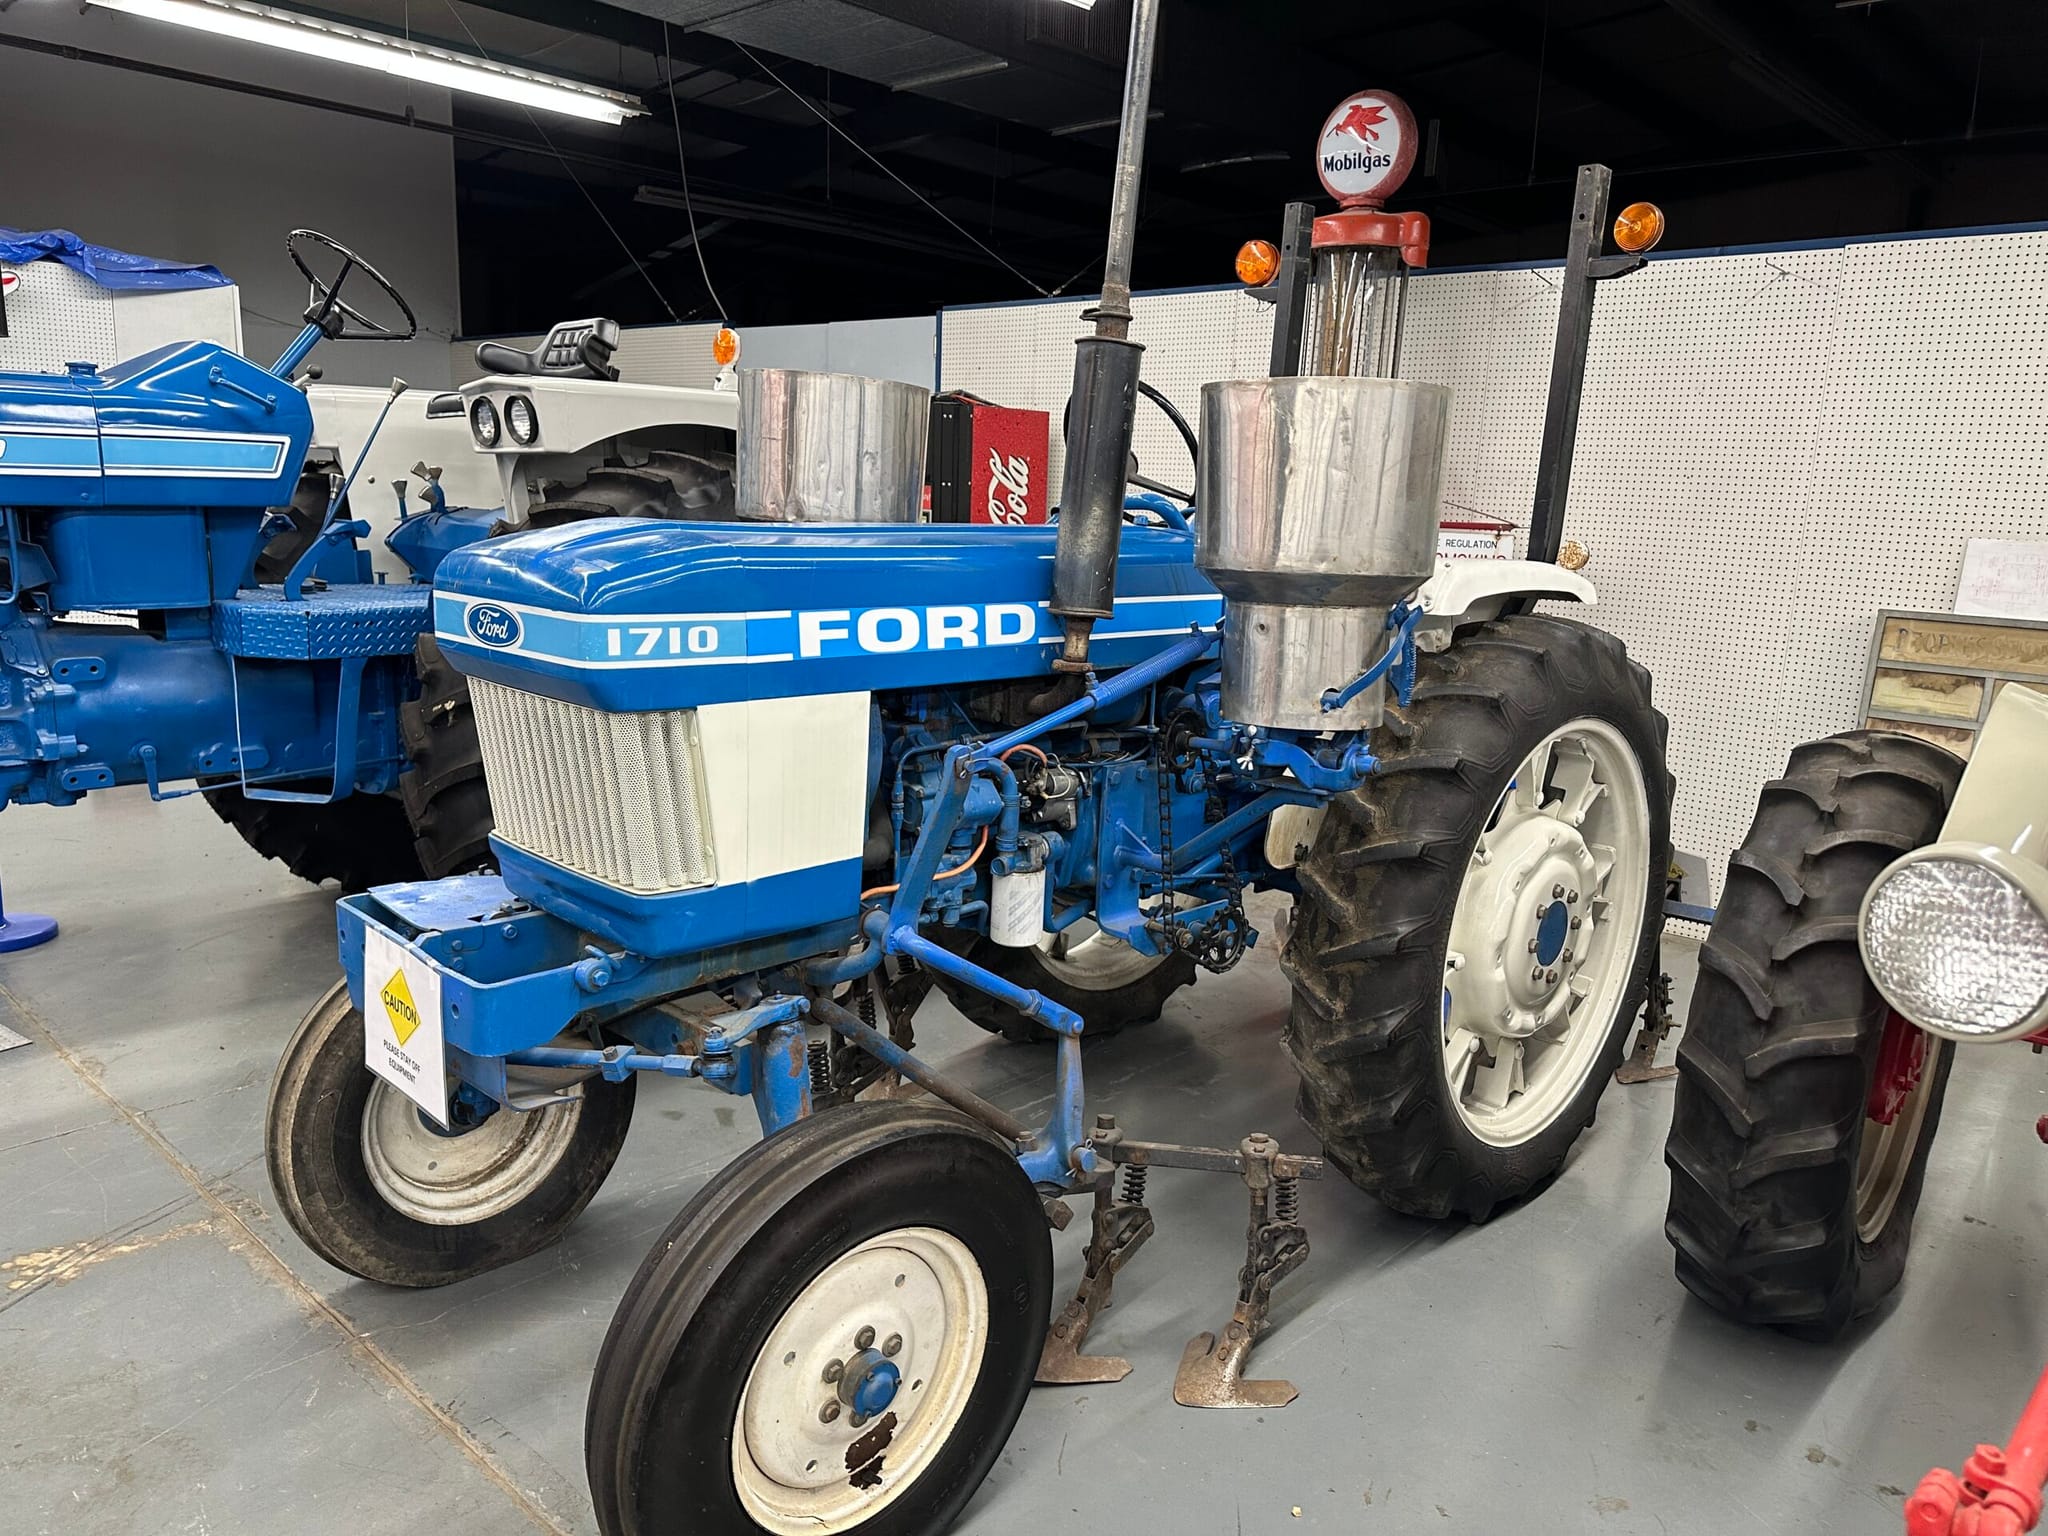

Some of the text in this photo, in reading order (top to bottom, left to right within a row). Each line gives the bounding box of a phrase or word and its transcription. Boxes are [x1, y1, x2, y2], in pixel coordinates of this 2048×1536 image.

[1322, 152, 1391, 173] Mobilgas
[1445, 539, 1498, 549] REGULATION
[477, 608, 509, 640] Ford
[798, 604, 1036, 658] FORD
[607, 625, 719, 656] 1710
[384, 990, 417, 1026] CAUTION
[383, 1039, 400, 1058] PLEASE
[400, 1051, 411, 1066] STAY
[388, 1057, 416, 1084] EQUIPMENT
